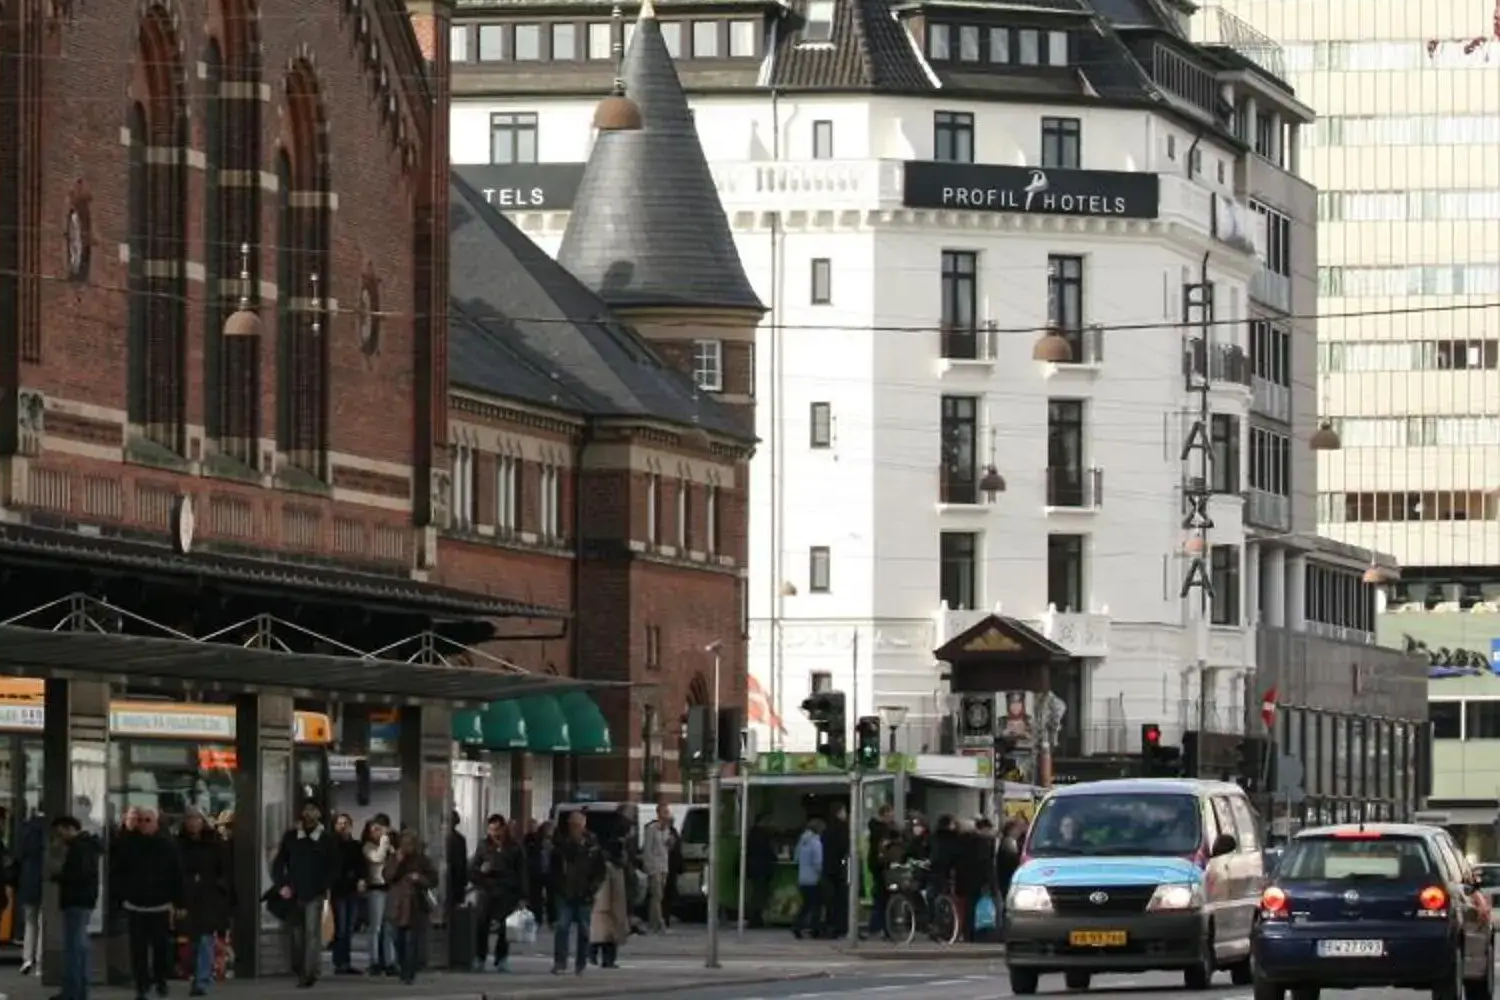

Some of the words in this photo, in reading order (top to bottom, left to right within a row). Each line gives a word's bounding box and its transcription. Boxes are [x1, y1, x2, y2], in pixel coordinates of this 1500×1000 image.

[482, 187, 546, 206] TELS
[942, 187, 1020, 208] PROFIL
[1042, 194, 1127, 214] HOTELS
